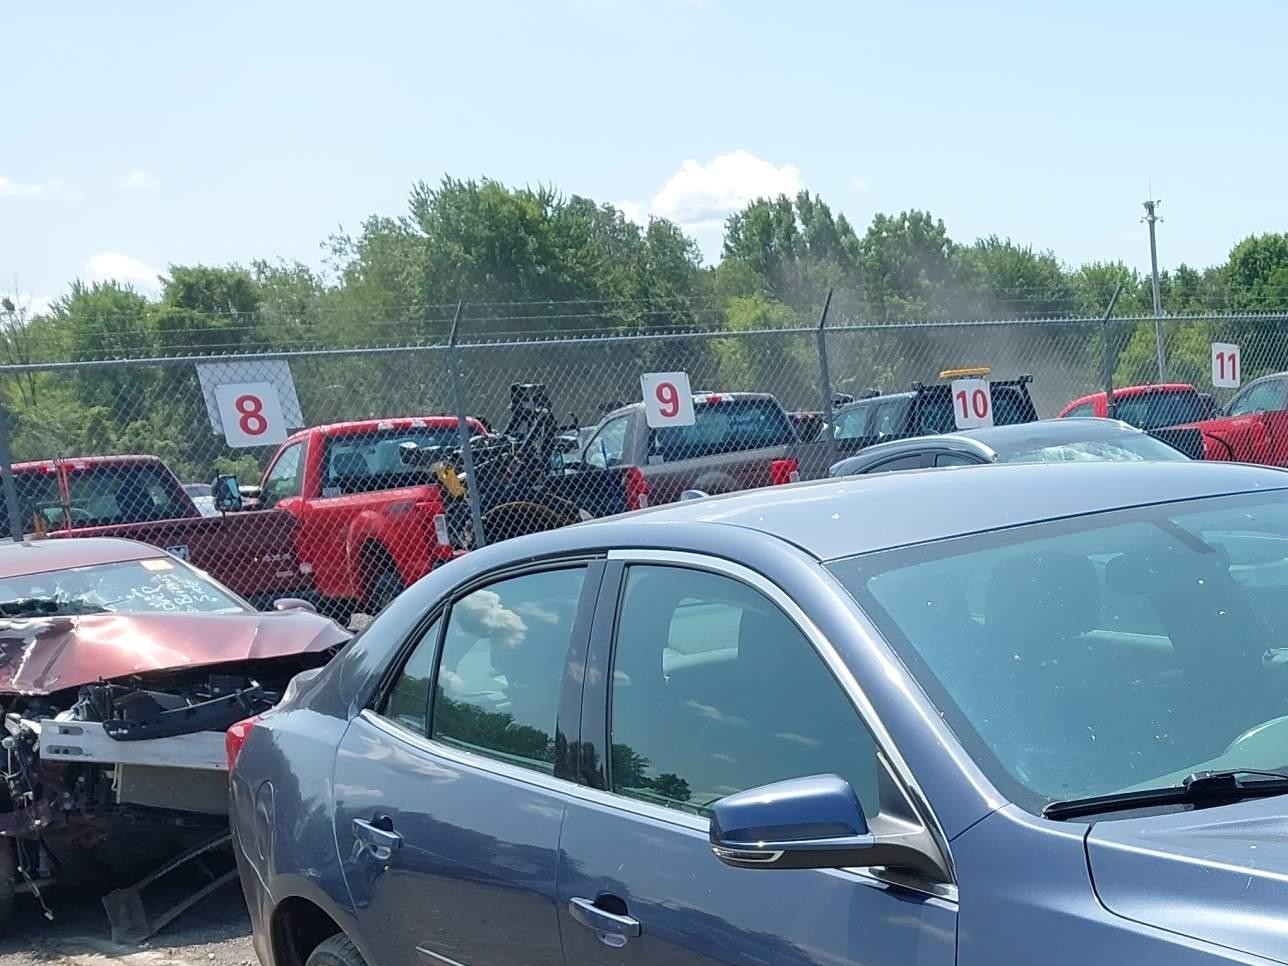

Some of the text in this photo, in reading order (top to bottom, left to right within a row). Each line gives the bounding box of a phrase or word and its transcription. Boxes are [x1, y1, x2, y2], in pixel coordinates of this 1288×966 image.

[1215, 351, 1237, 381] 11
[235, 394, 268, 436] 8
[655, 382, 680, 418] 9
[956, 389, 990, 418] 10
